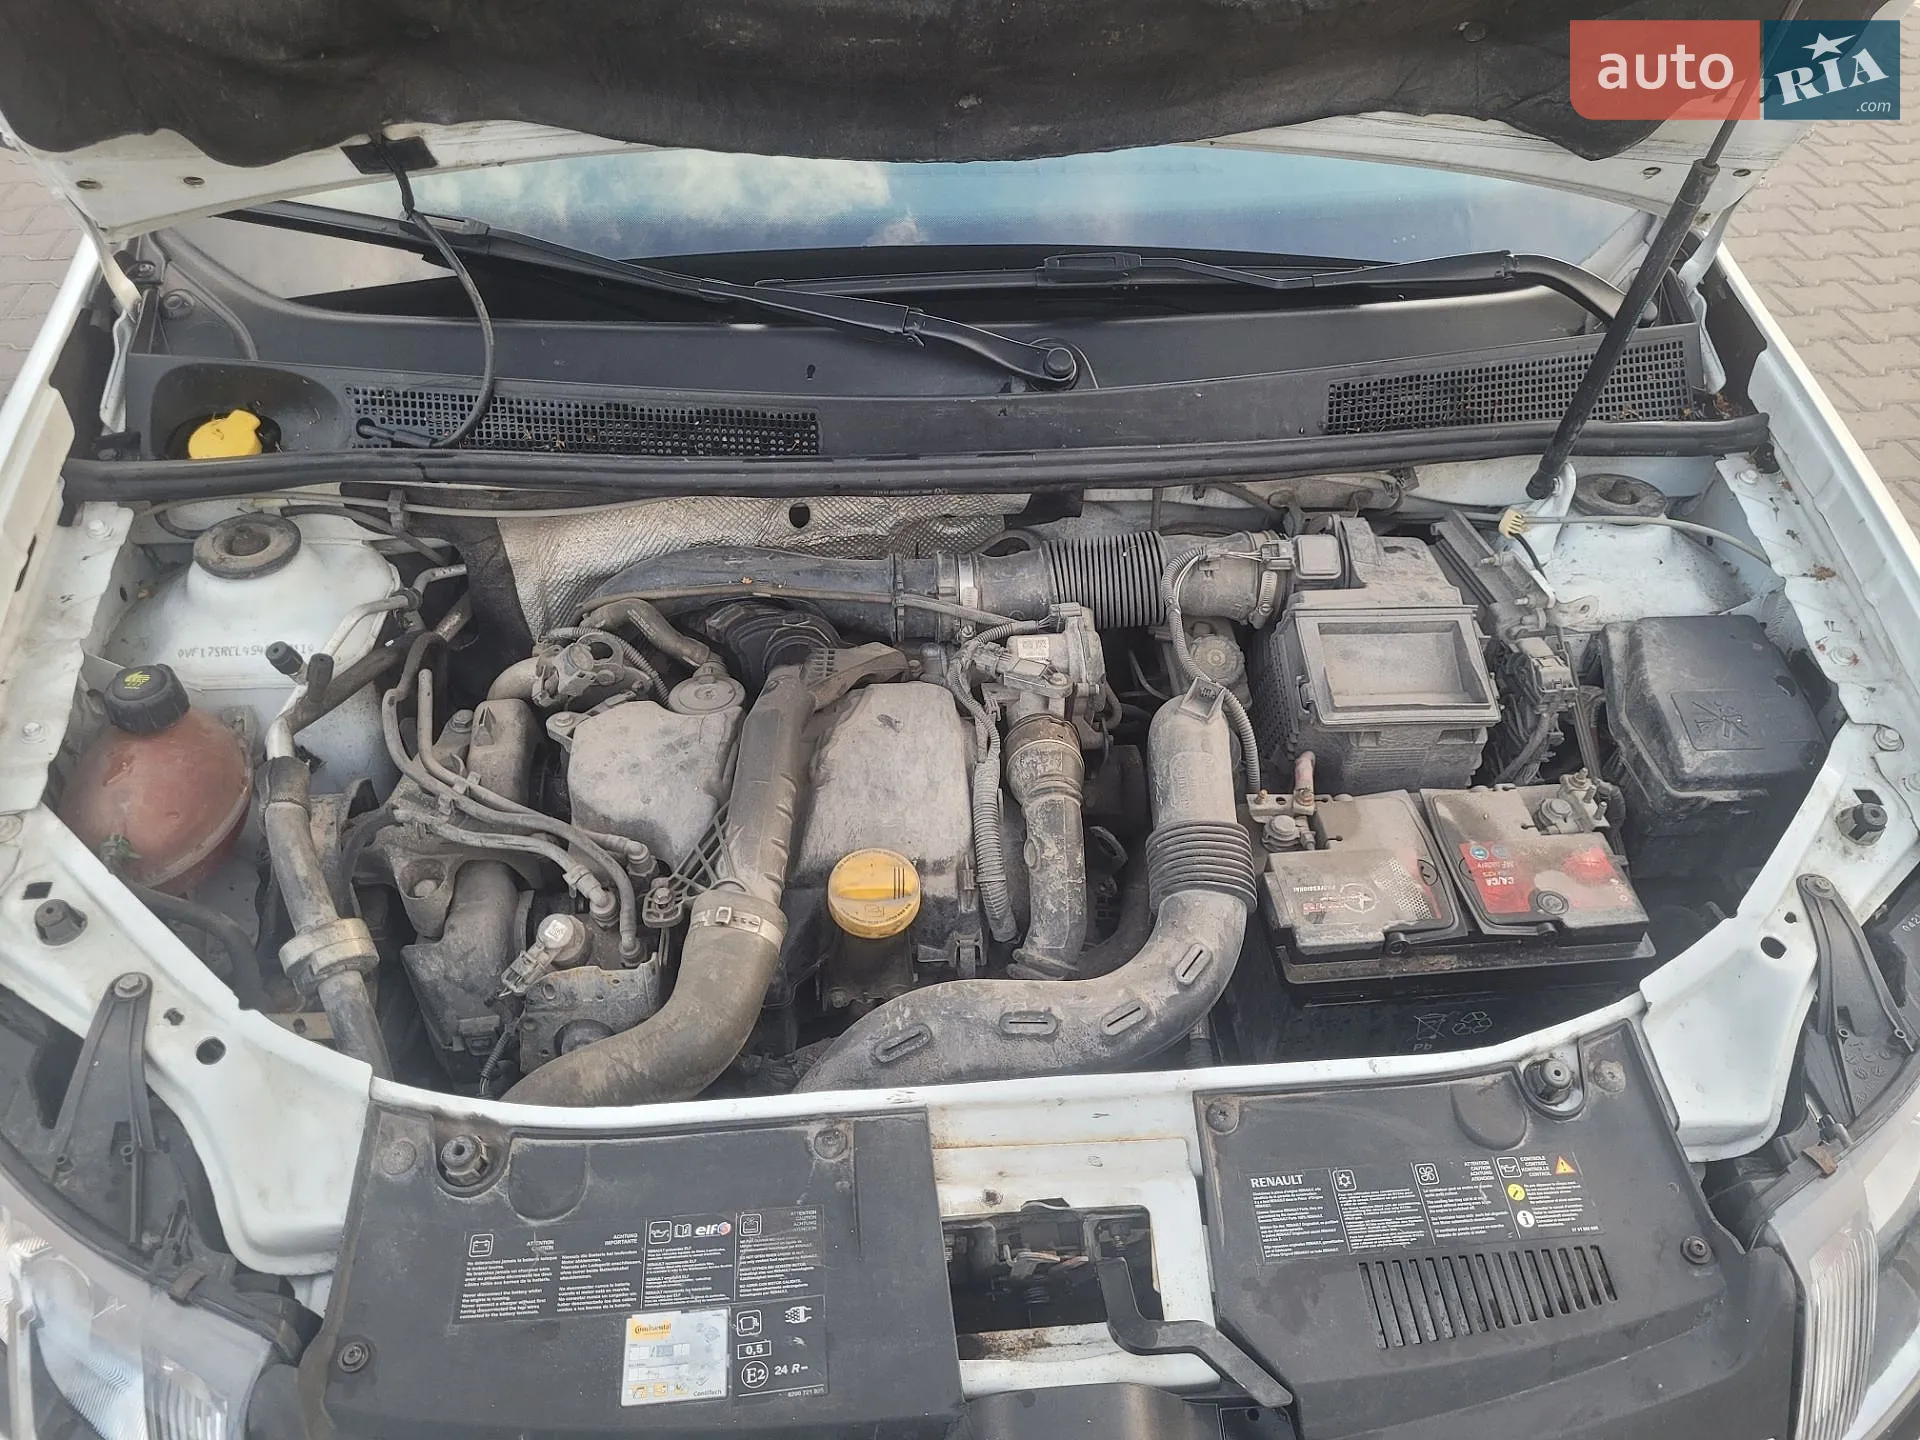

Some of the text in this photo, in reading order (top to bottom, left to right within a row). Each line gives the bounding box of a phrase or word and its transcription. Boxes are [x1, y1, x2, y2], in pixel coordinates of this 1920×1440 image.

[1250, 1174, 1303, 1188] RENAULT
[695, 1224, 718, 1236] elf
[745, 1344, 763, 1355] 0,5
[746, 1367, 766, 1383] E2
[774, 1365, 788, 1375] 24
